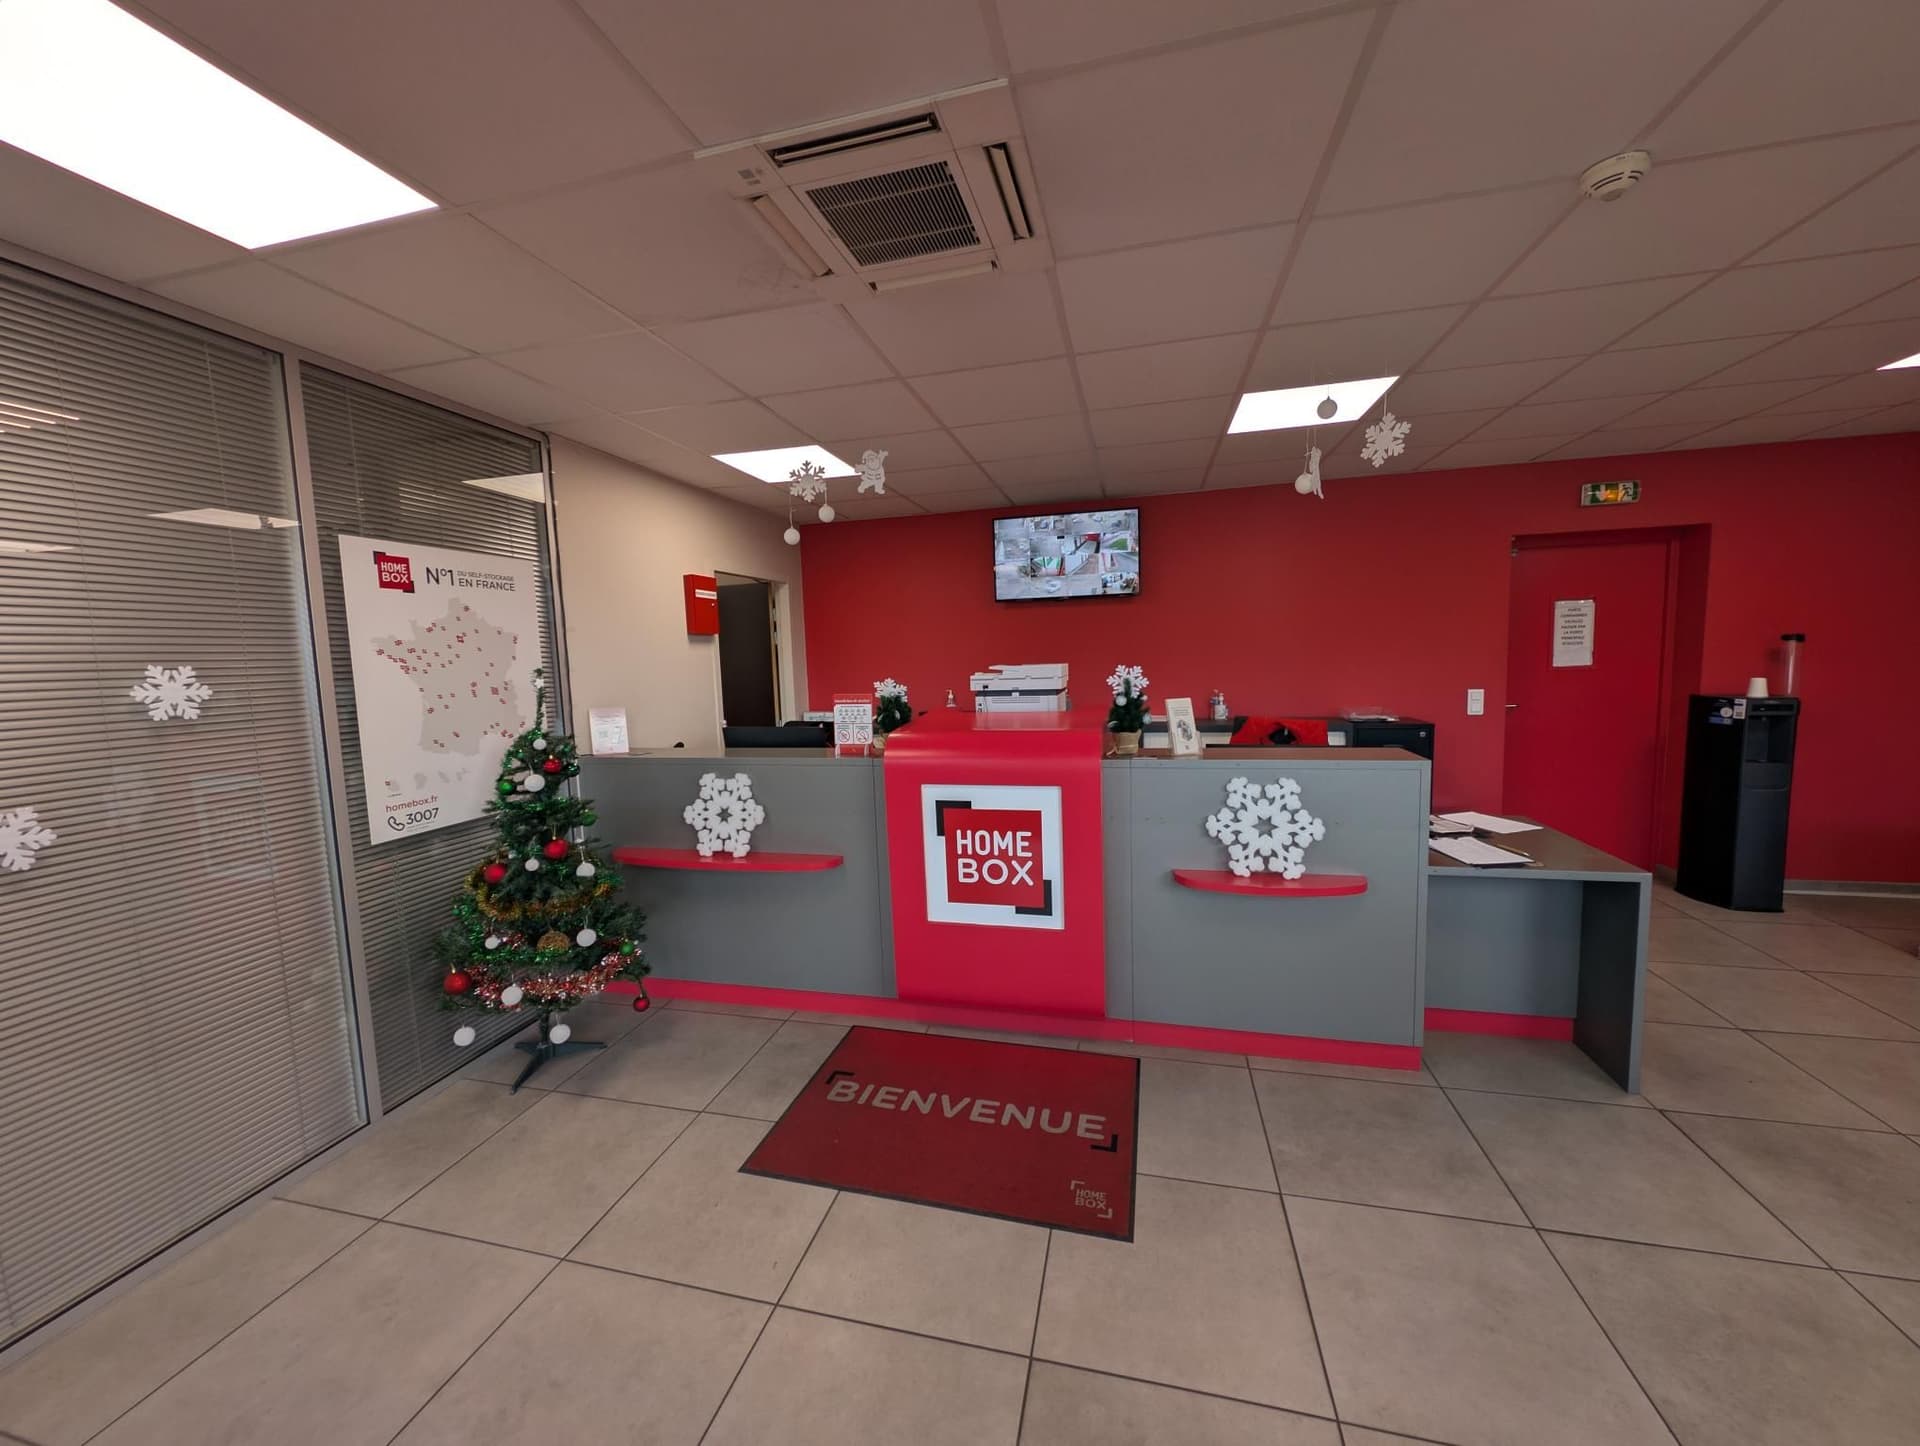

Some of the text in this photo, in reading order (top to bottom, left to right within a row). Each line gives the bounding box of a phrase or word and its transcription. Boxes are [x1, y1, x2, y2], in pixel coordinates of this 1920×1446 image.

[381, 562, 408, 574] HOME
[382, 572, 409, 584] BOX
[458, 578, 516, 592] EN FRANCE
[385, 794, 438, 813] homebox.fr
[406, 807, 440, 825] 3007
[956, 829, 1033, 858] HOME
[957, 858, 1034, 887] BOX
[826, 1079, 1107, 1140] BIENVENUE
[1076, 1189, 1106, 1201] HOME
[1075, 1198, 1106, 1210] BOX
